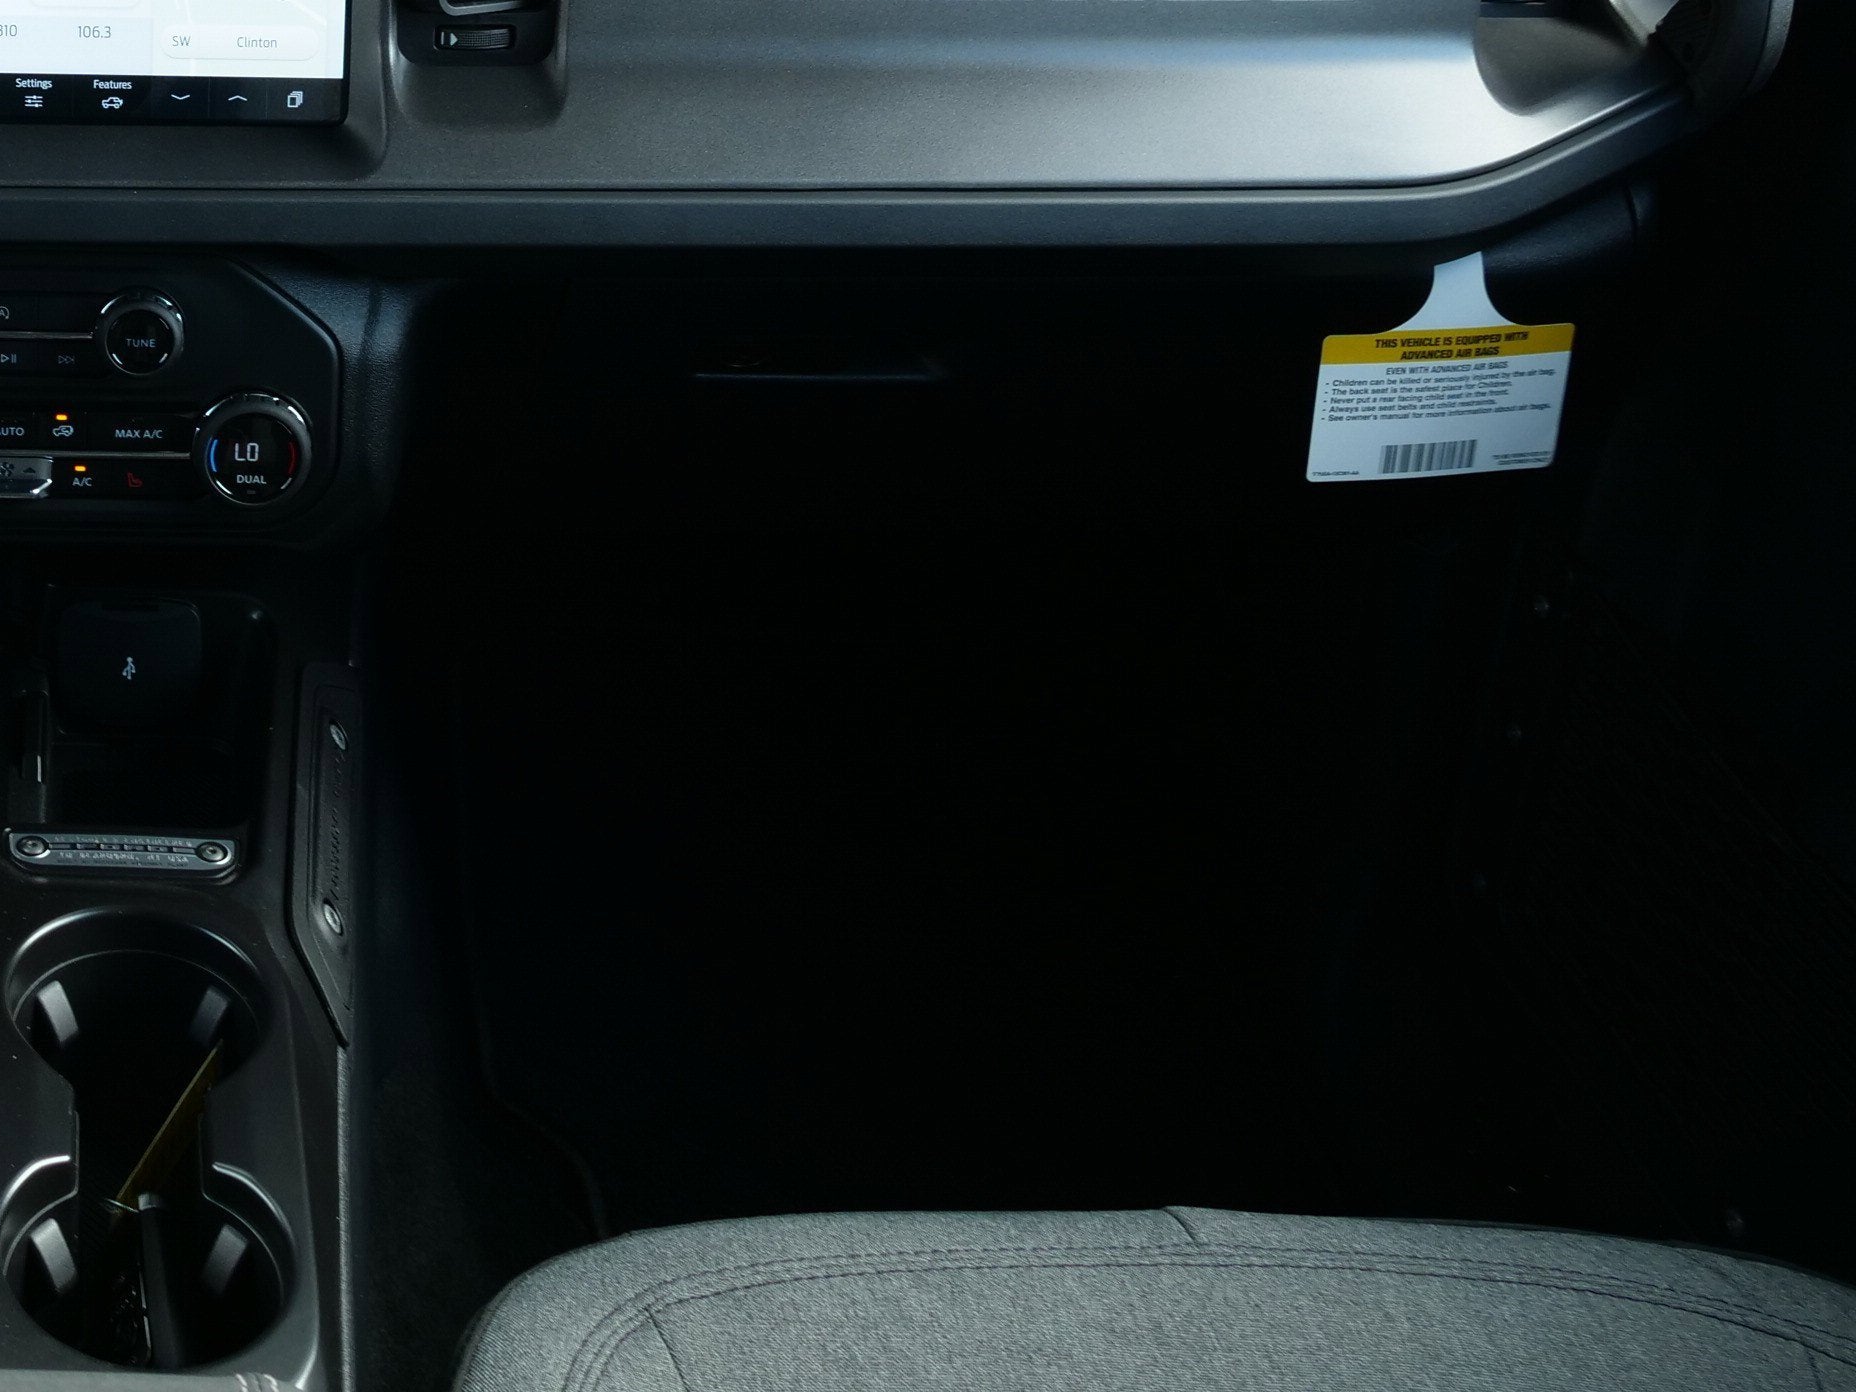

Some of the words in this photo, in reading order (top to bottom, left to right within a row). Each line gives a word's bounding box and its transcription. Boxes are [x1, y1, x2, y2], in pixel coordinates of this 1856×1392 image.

[77, 25, 112, 39] 106.3
[172, 35, 191, 46] SW
[237, 36, 277, 48] Clinton
[15, 78, 53, 89] Settings
[93, 79, 132, 90] Features
[126, 338, 156, 348] TUNE
[1375, 339, 1399, 349] THIS
[1400, 337, 1441, 348] VEHICLE
[1443, 336, 1453, 346] IS
[1455, 334, 1502, 345] EQUIPPED
[1504, 331, 1530, 342] WITH
[1400, 349, 1454, 360] ADVANCED
[1456, 348, 1472, 358] AIR
[1475, 346, 1500, 356] BAGS
[1386, 367, 1407, 376] EVEN
[1408, 365, 1430, 375] WITH
[1332, 379, 1368, 387] Children
[1386, 377, 1397, 385] be
[1371, 387, 1388, 395] seat
[1330, 397, 1355, 405] Never
[1328, 414, 1343, 422] See
[115, 429, 141, 438] MAX
[143, 429, 163, 440] A/C
[234, 442, 260, 462] LO
[72, 476, 93, 488] A/C
[236, 474, 266, 484] DUAL
